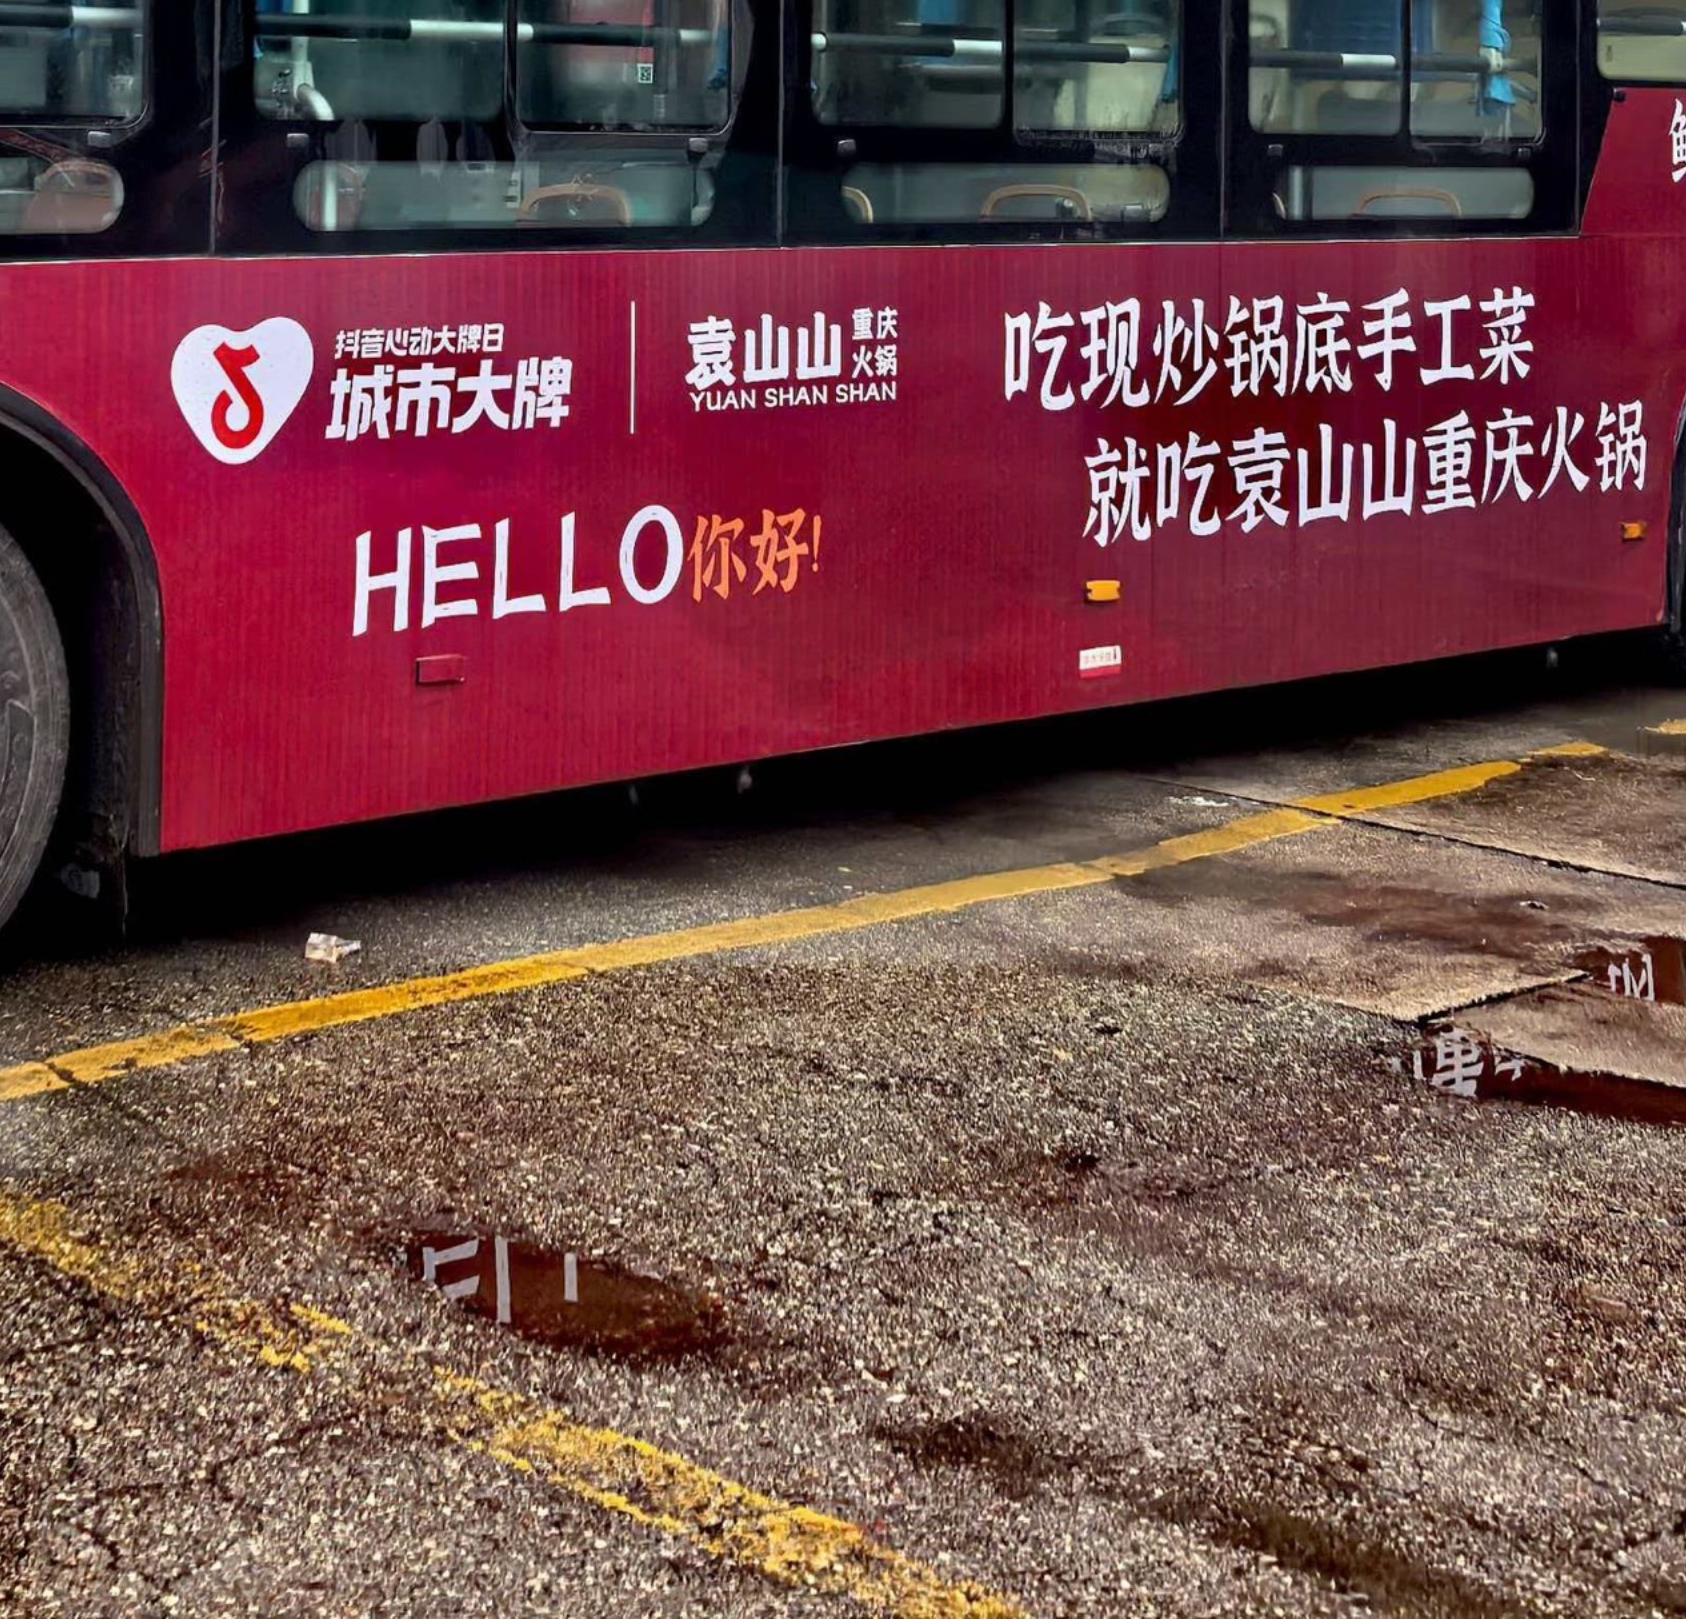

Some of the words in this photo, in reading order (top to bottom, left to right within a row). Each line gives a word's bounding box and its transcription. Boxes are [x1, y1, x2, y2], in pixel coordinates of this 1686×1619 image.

[334, 322, 505, 360] 抖音心动大牌日
[684, 311, 843, 391] 袁山山
[850, 306, 899, 342] 重庆
[850, 344, 898, 380] 火锅
[1003, 285, 1536, 412] 吃现炒锅底手工菜
[324, 355, 574, 442] 城市大牌
[689, 388, 757, 413] YUAN
[764, 385, 828, 409] SHAN
[835, 381, 898, 404] SHAN
[1082, 398, 1649, 548] 就吃袁山山重庆火锅
[352, 504, 684, 638] HELLO
[686, 506, 822, 604] 你好!
